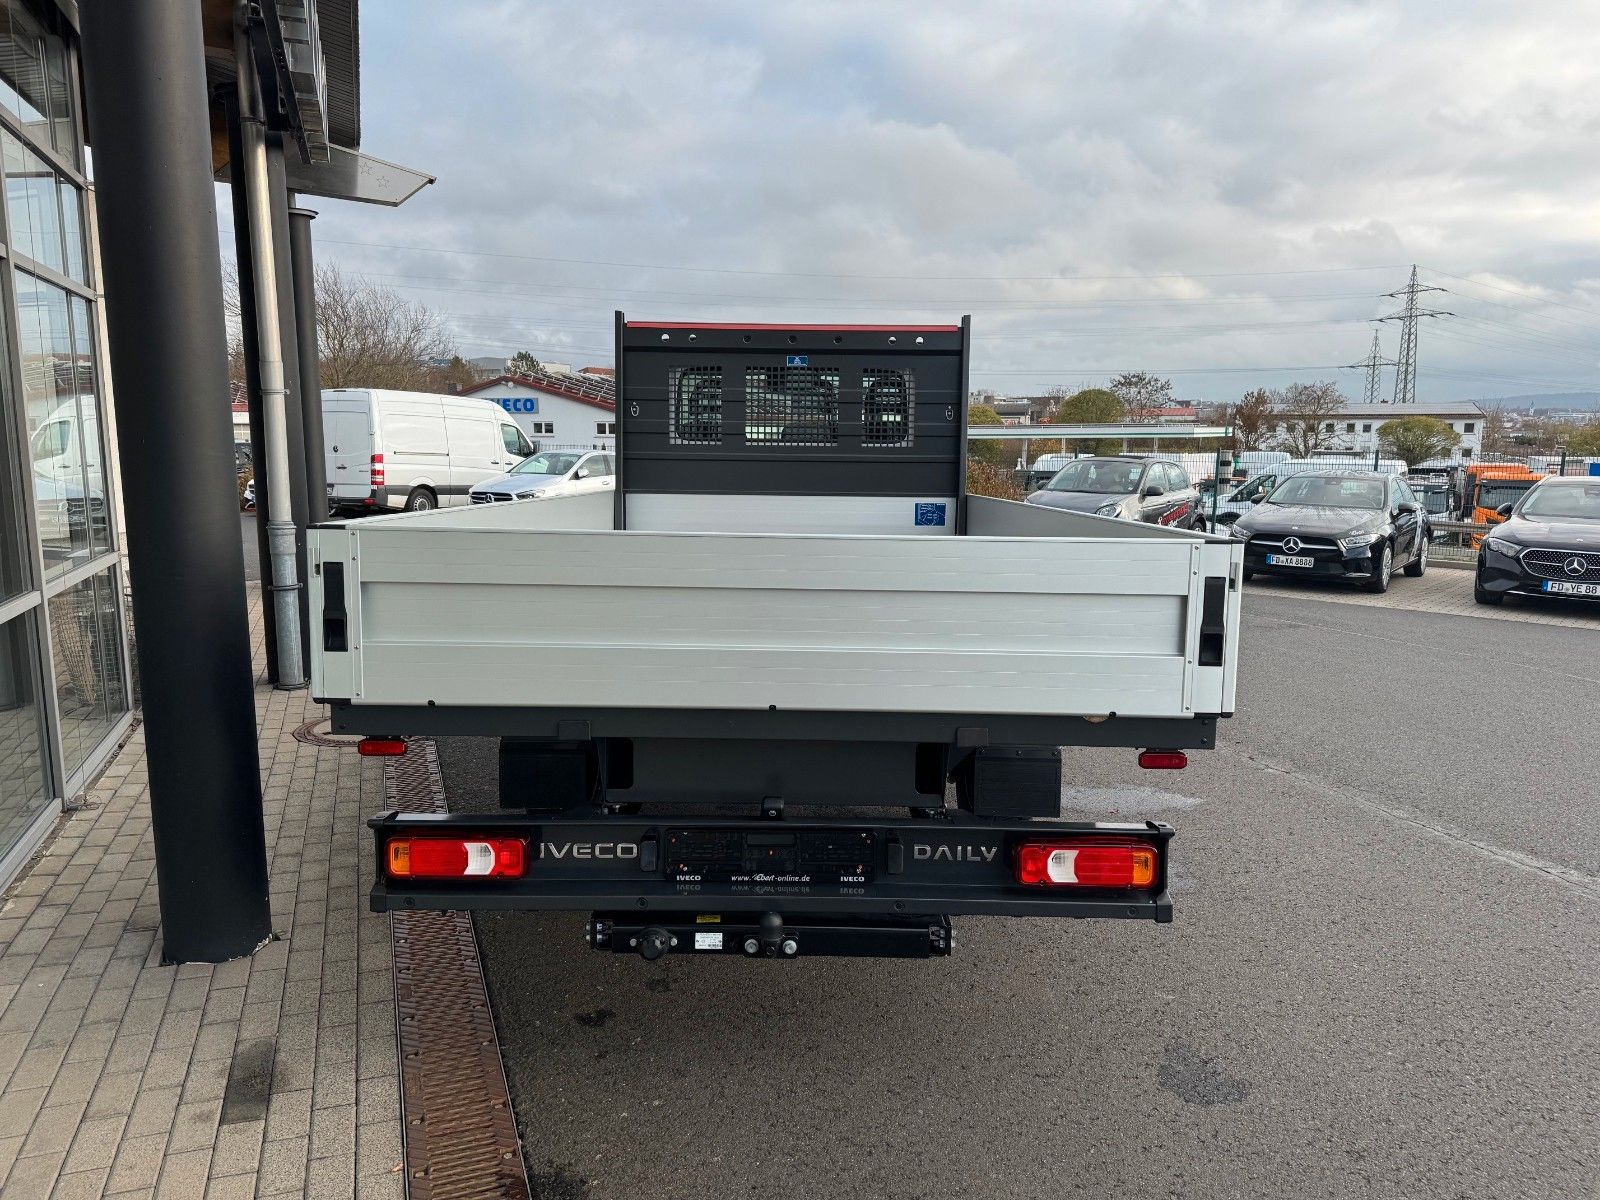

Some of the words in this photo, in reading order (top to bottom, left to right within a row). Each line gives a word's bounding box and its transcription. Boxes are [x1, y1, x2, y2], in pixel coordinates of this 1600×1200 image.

[490, 398, 535, 412] ECO
[1550, 582, 1564, 591] FD
[1570, 583, 1583, 593] YE
[540, 842, 638, 859] IVECO
[913, 843, 998, 861] DAILY
